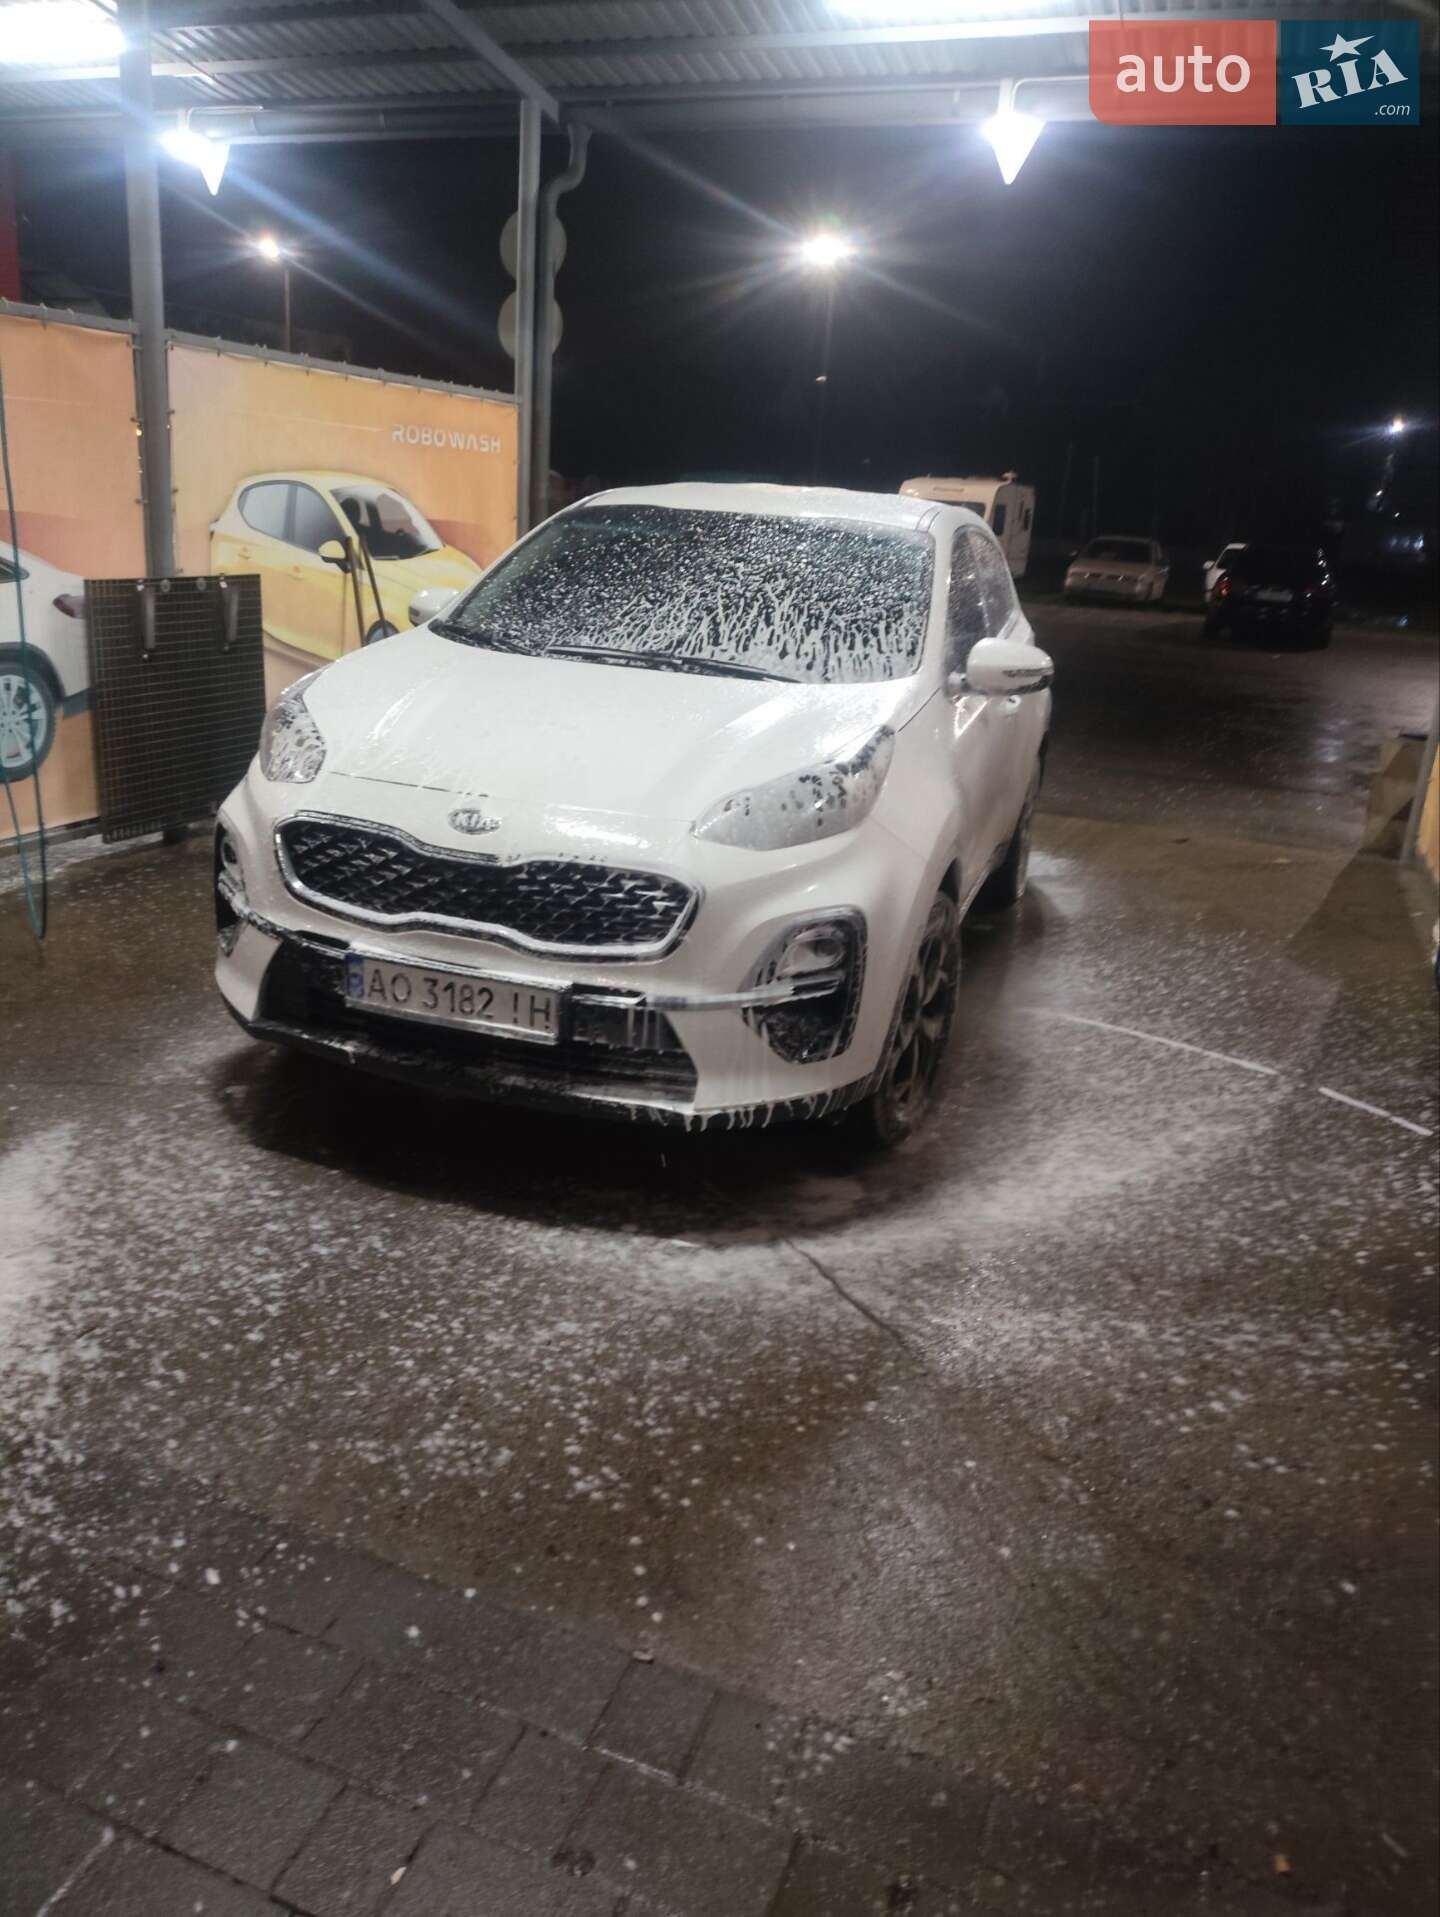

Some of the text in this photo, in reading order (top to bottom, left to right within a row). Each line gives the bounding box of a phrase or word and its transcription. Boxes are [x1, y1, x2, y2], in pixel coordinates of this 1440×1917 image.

[367, 969, 412, 1003] AO
[422, 977, 495, 1019] 3182
[512, 992, 551, 1029] IH
